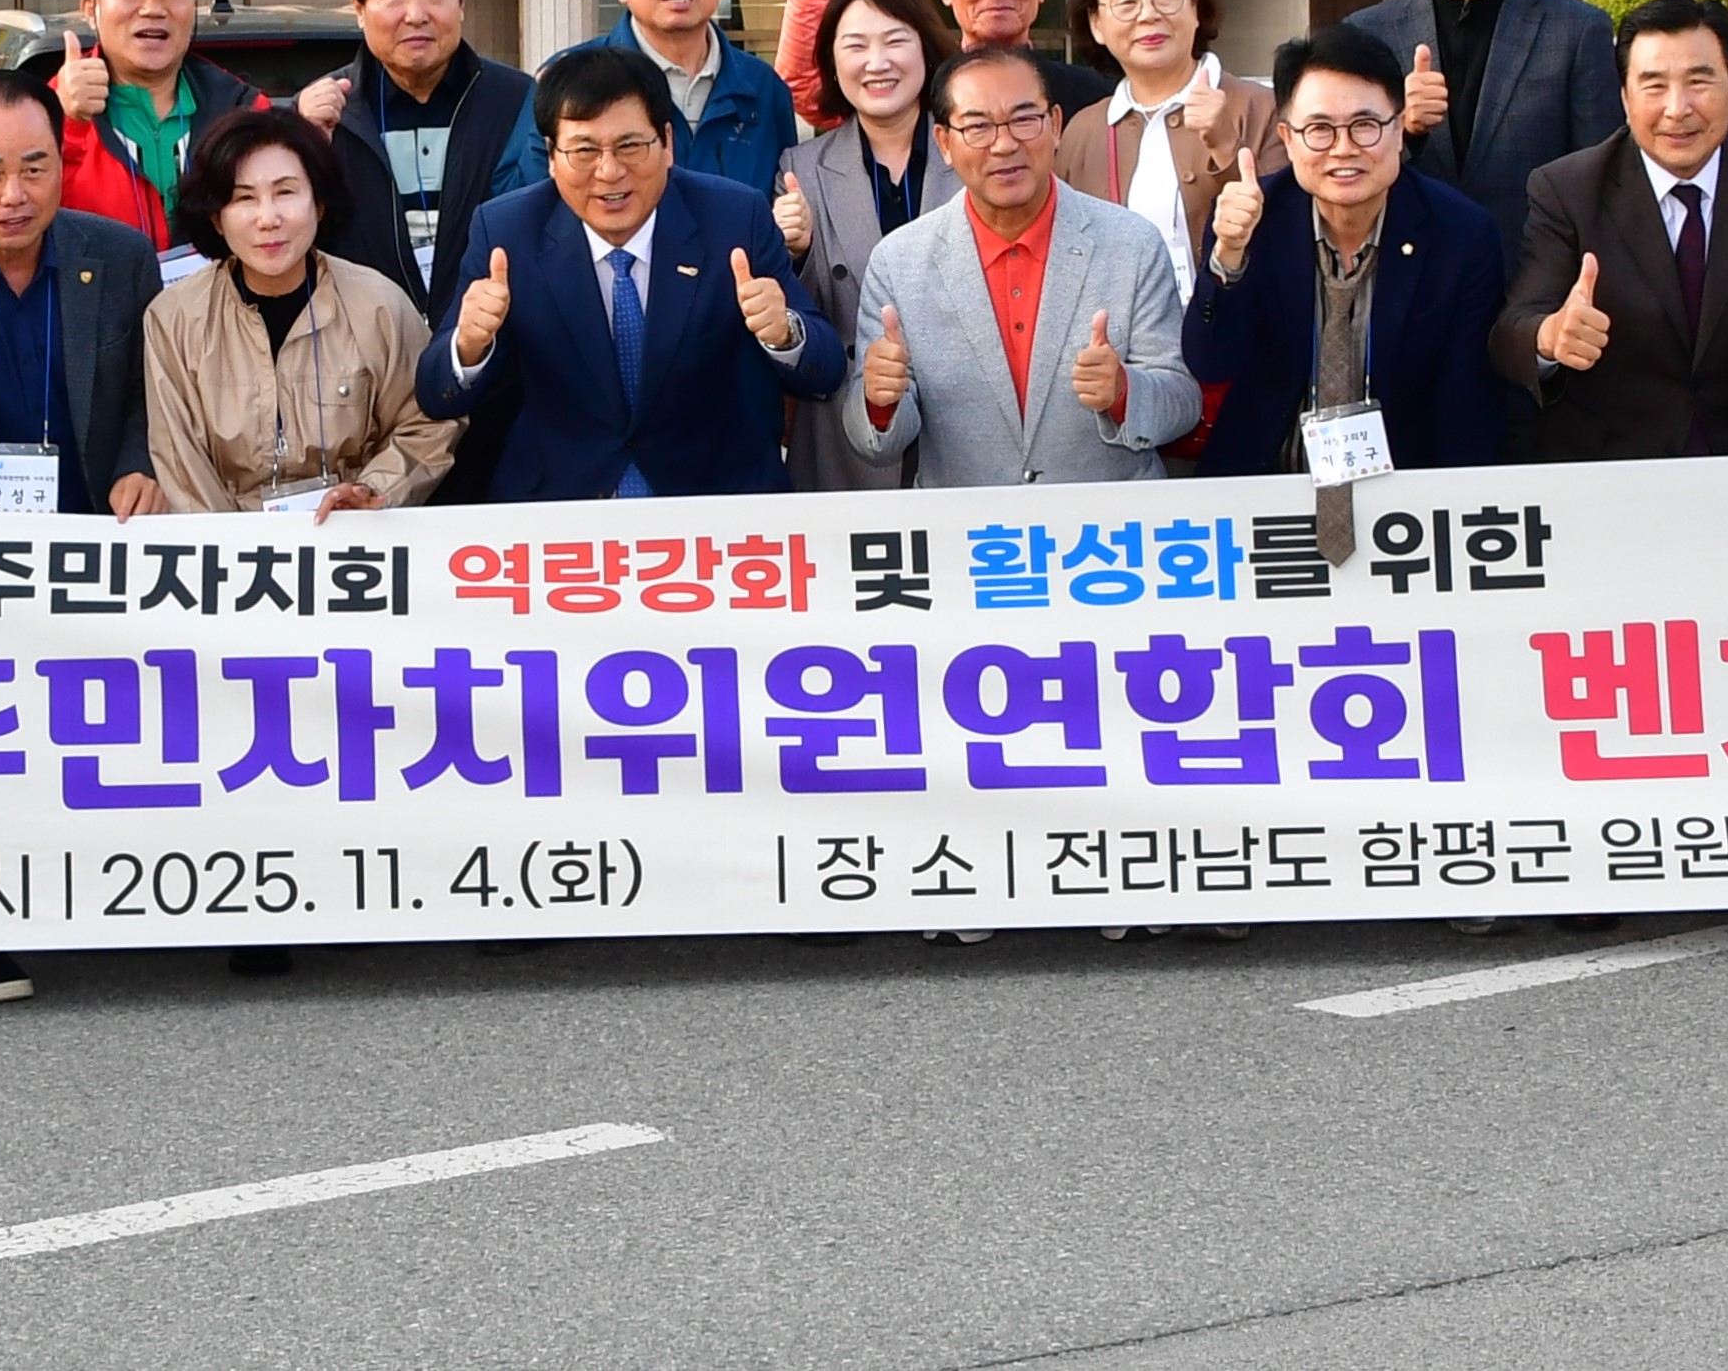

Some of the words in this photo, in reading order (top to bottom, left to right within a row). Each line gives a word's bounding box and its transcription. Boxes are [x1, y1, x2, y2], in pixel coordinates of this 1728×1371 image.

[448, 533, 817, 616] 역량강화
[849, 529, 933, 612] 및
[966, 515, 1332, 611] 활성화를
[1370, 504, 1552, 596] 위한
[101, 849, 316, 917] 2025.
[342, 847, 424, 911] 11.
[1045, 825, 1332, 896] 전라남도
[1358, 820, 1573, 888] 함평군
